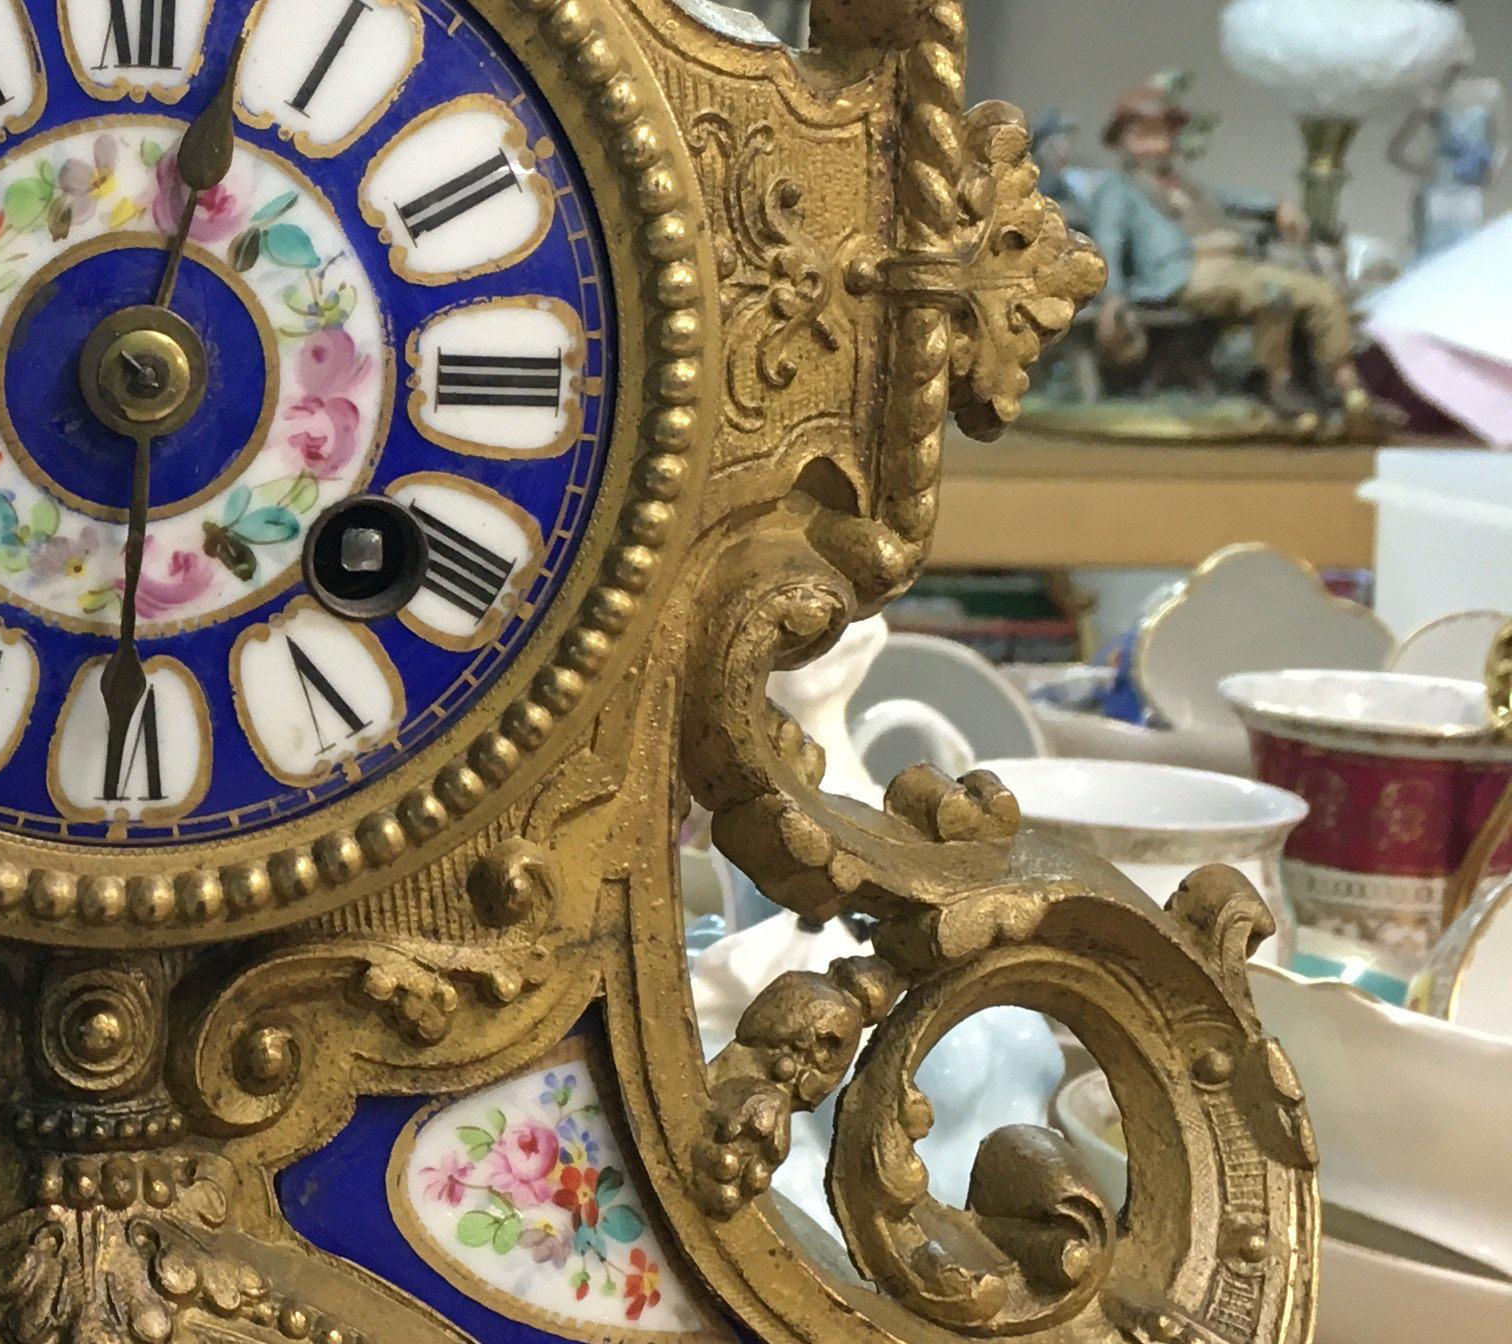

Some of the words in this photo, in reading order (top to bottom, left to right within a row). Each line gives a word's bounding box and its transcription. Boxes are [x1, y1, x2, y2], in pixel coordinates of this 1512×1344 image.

[394, 149, 522, 246] II
[434, 346, 561, 416] III
[286, 635, 373, 755] V
